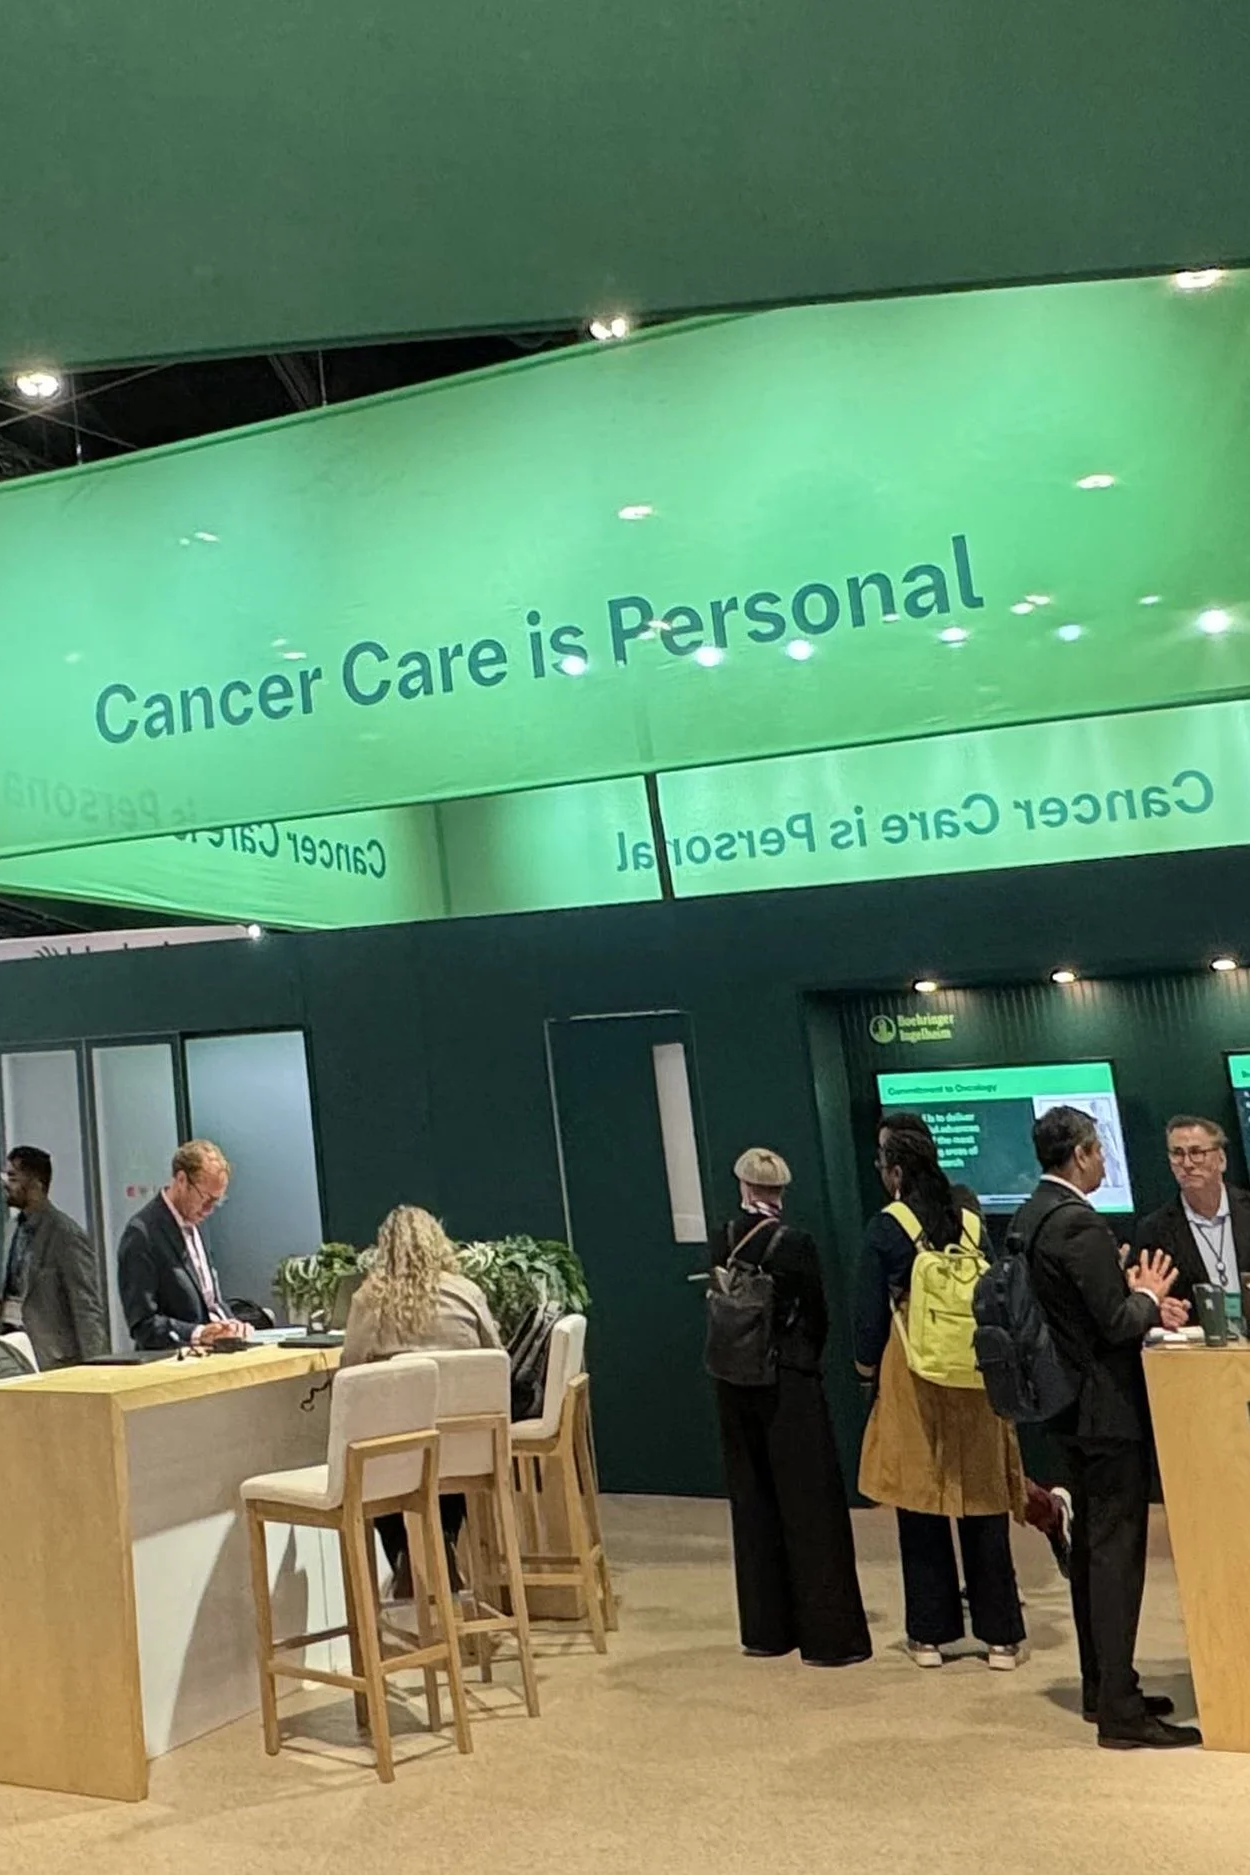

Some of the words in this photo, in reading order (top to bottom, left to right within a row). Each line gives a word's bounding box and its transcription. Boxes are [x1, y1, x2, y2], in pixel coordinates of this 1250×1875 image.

[96, 666, 322, 745] Cancer
[342, 637, 508, 706] Care
[526, 610, 589, 680] is
[607, 534, 985, 666] Personal
[954, 1083, 997, 1094] Oncology
